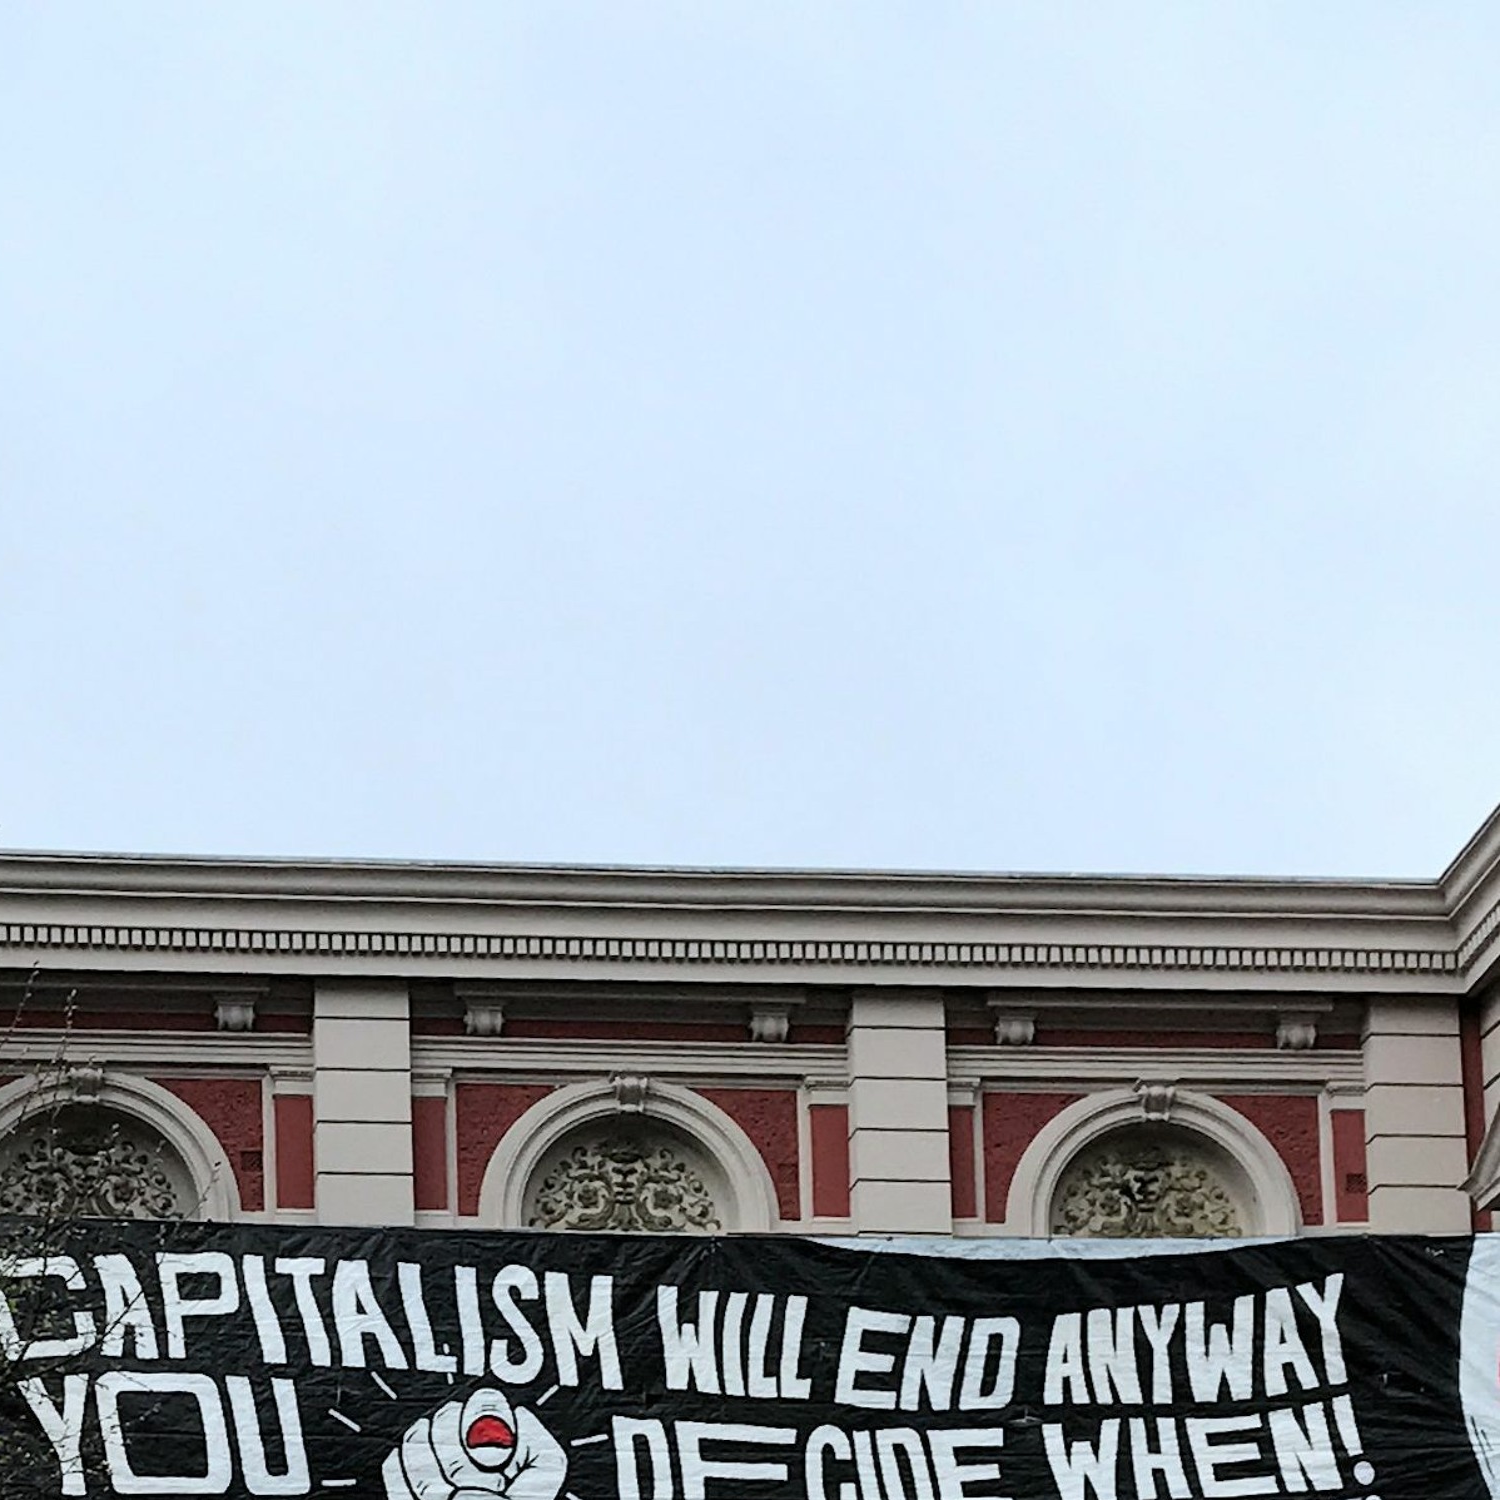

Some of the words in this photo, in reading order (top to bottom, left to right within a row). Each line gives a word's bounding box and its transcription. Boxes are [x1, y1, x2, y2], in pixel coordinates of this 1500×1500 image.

[656, 1283, 812, 1401] WILL
[833, 1306, 1022, 1412] END
[1042, 1272, 1349, 1407] ANYWAY
[17, 1369, 313, 1498] YOU
